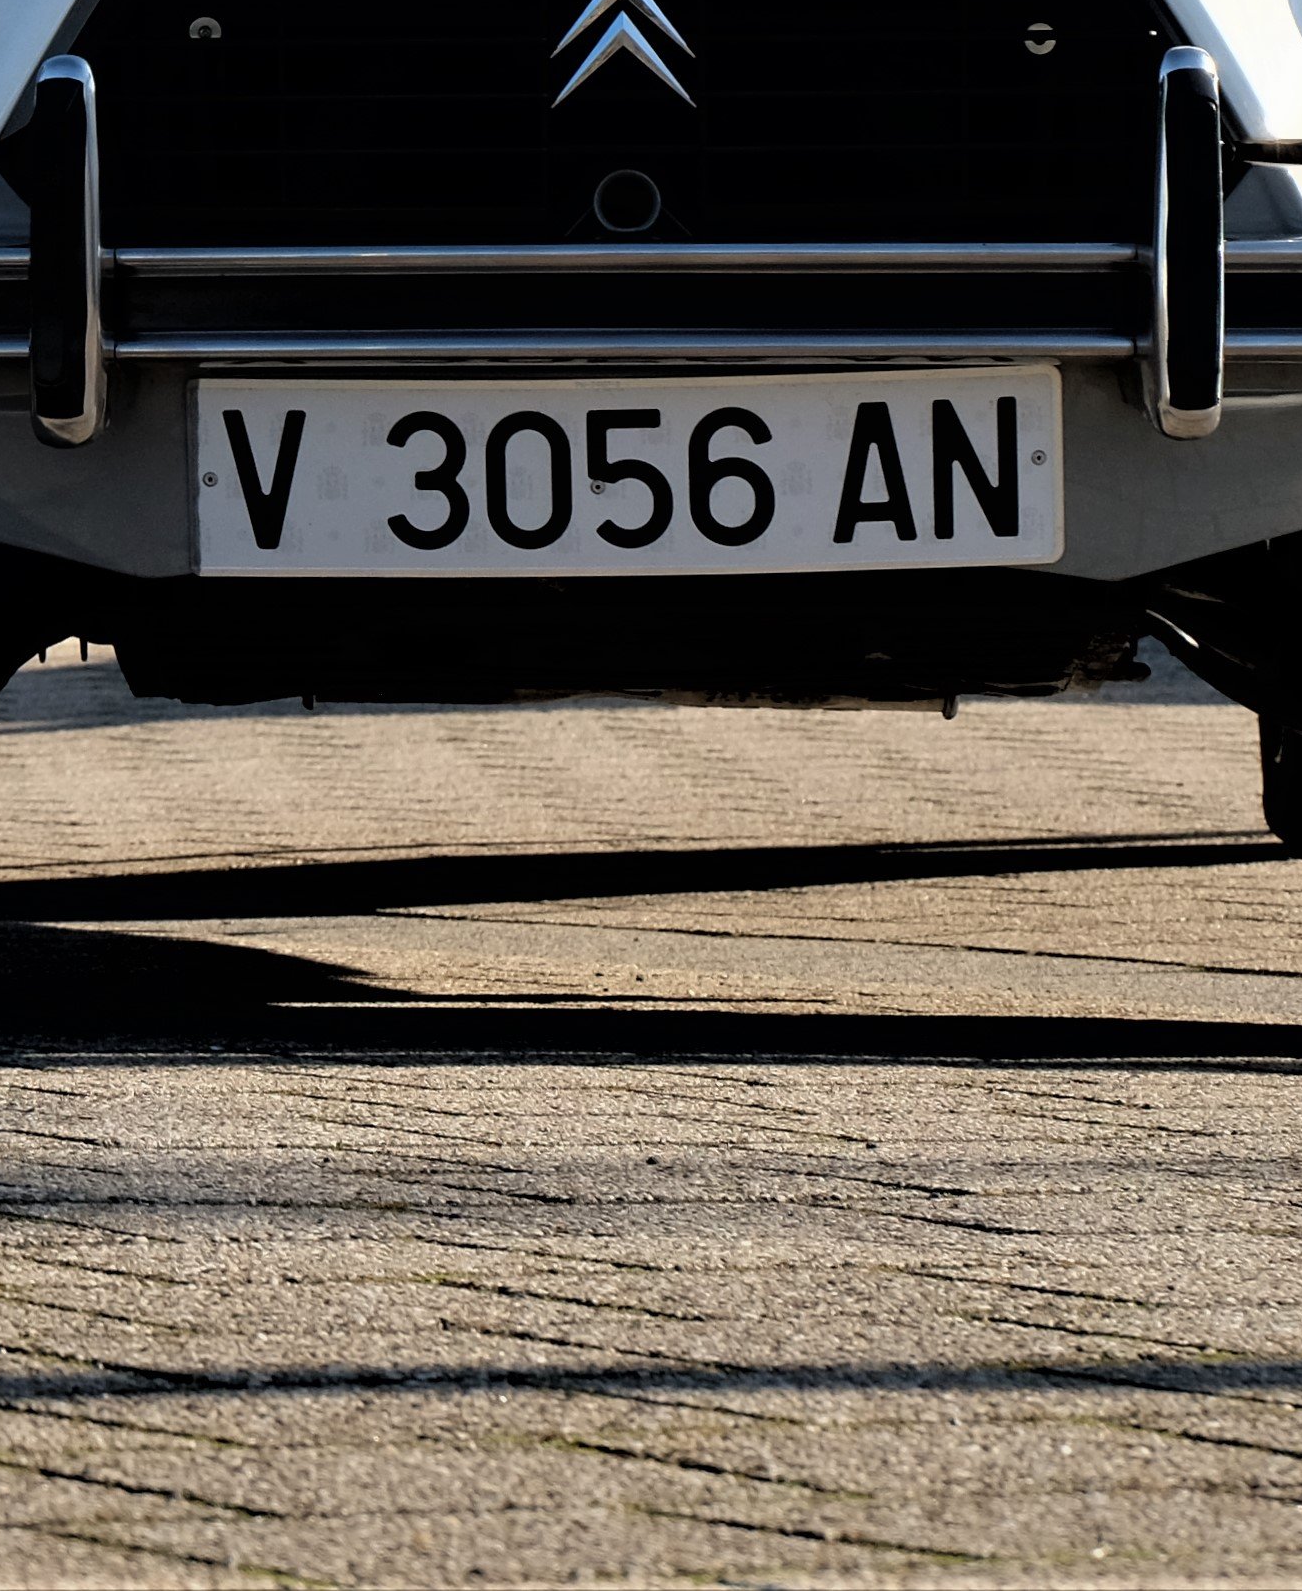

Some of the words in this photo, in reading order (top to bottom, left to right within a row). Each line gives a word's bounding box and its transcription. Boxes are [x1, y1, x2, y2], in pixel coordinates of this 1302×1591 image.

[222, 409, 307, 550] V
[386, 406, 776, 551] 3056
[832, 396, 1019, 544] AN
